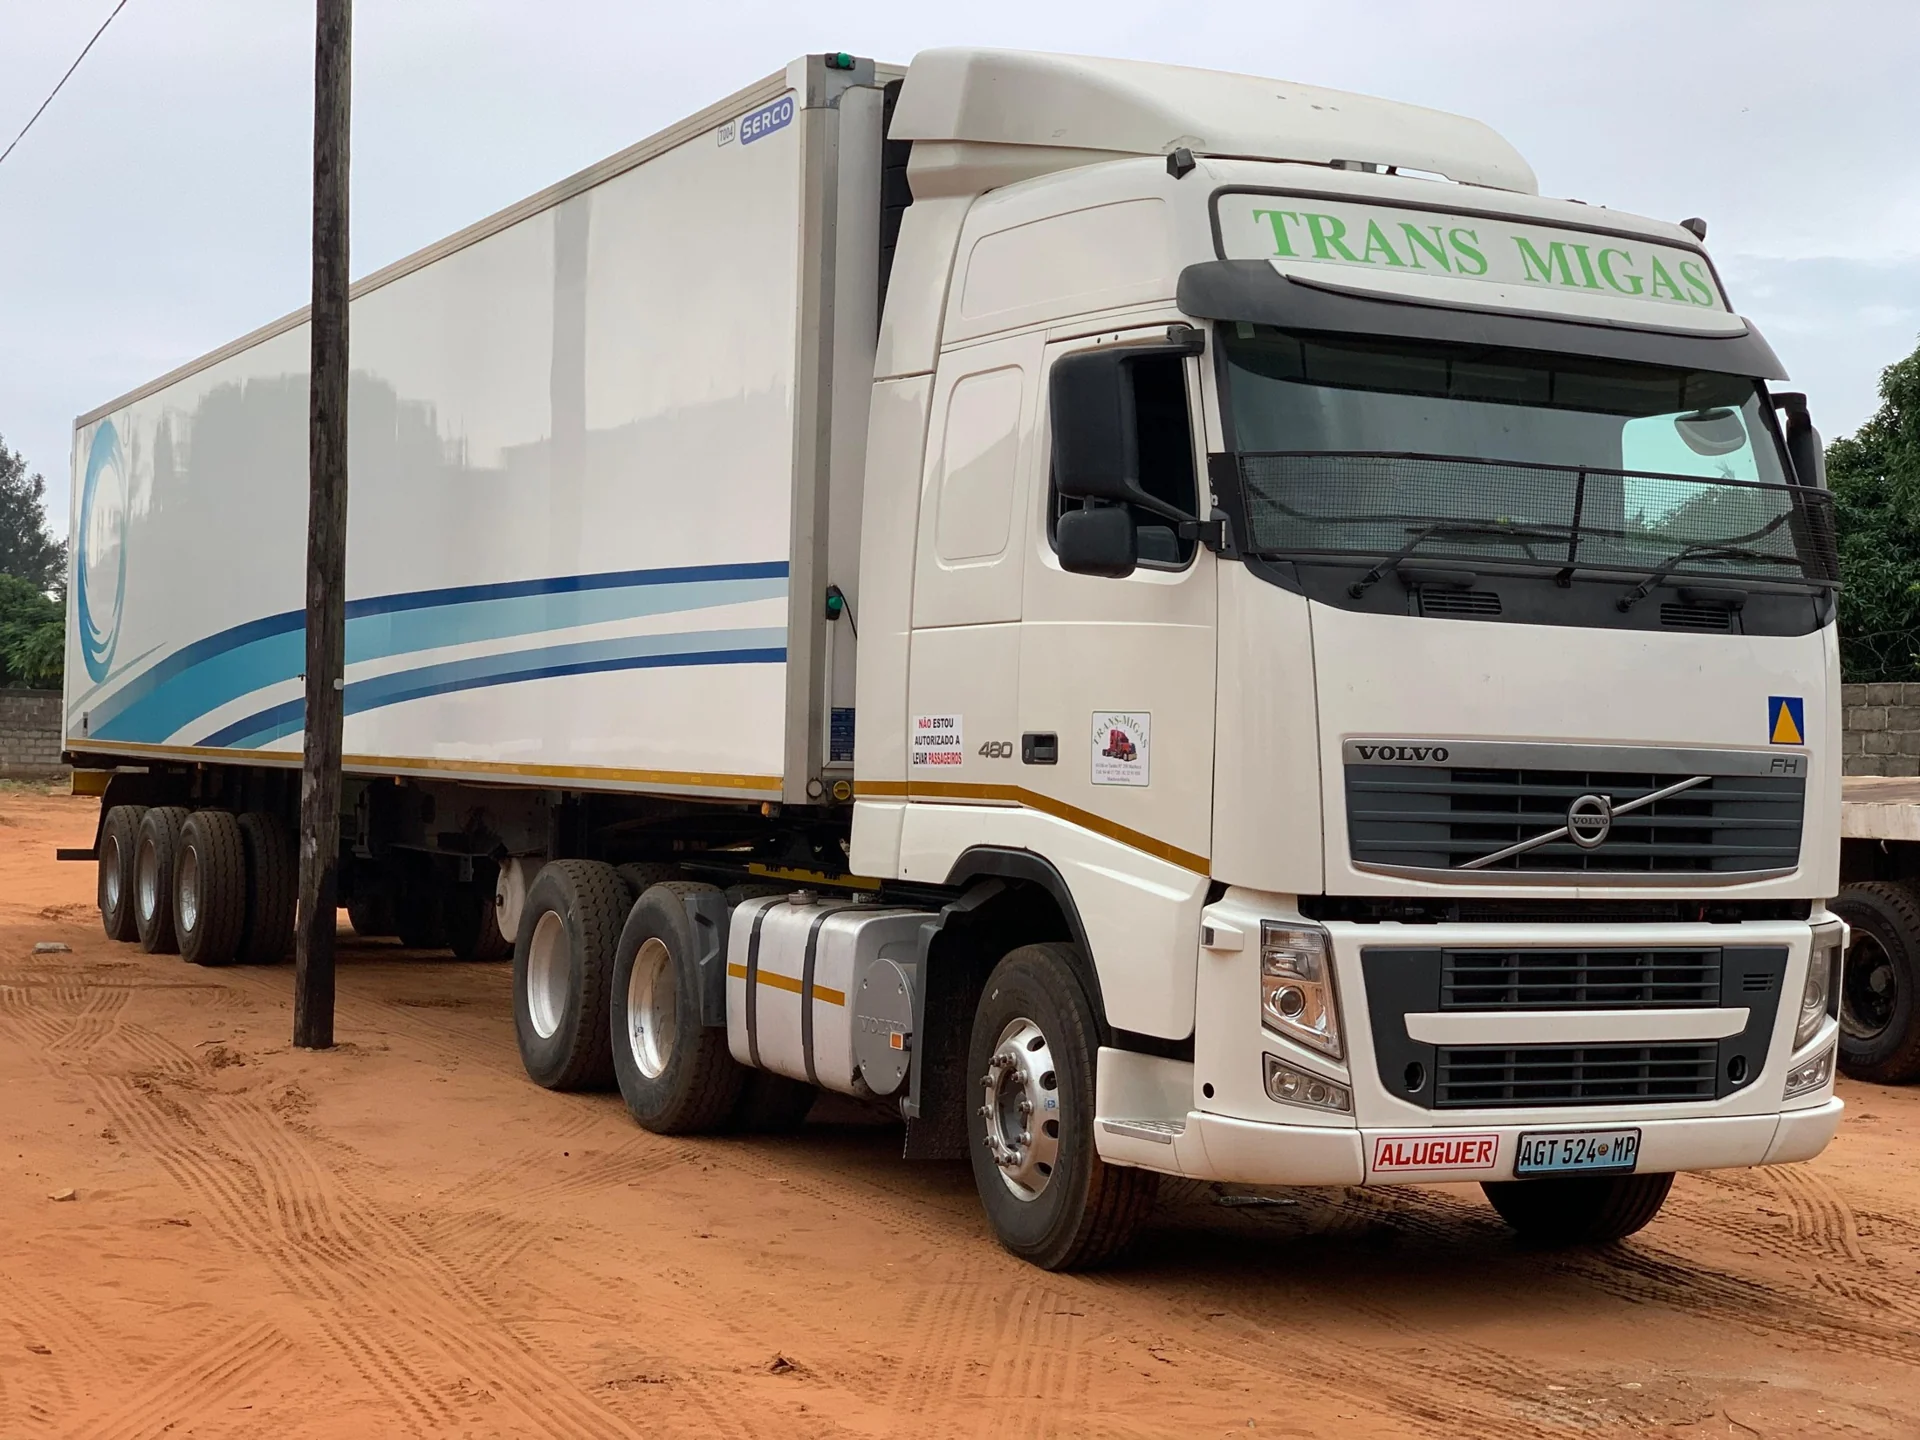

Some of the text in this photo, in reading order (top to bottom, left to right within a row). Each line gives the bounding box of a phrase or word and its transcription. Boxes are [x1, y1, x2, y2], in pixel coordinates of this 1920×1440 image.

[743, 102, 791, 140] SERCO
[1253, 208, 1714, 307] TRANS MIGAS
[918, 716, 954, 729] NÃO ESTOU
[914, 735, 960, 746] AUTORIZADO A
[912, 751, 962, 765] LEVAR PASSAGEIROS
[978, 741, 1013, 758] 480
[1355, 745, 1449, 762] VOLVO
[1770, 758, 1797, 774] FH
[1572, 817, 1609, 825] VOLVO
[1378, 1140, 1493, 1166] ALUGUER
[1520, 1136, 1636, 1166] AGT 524 MP
